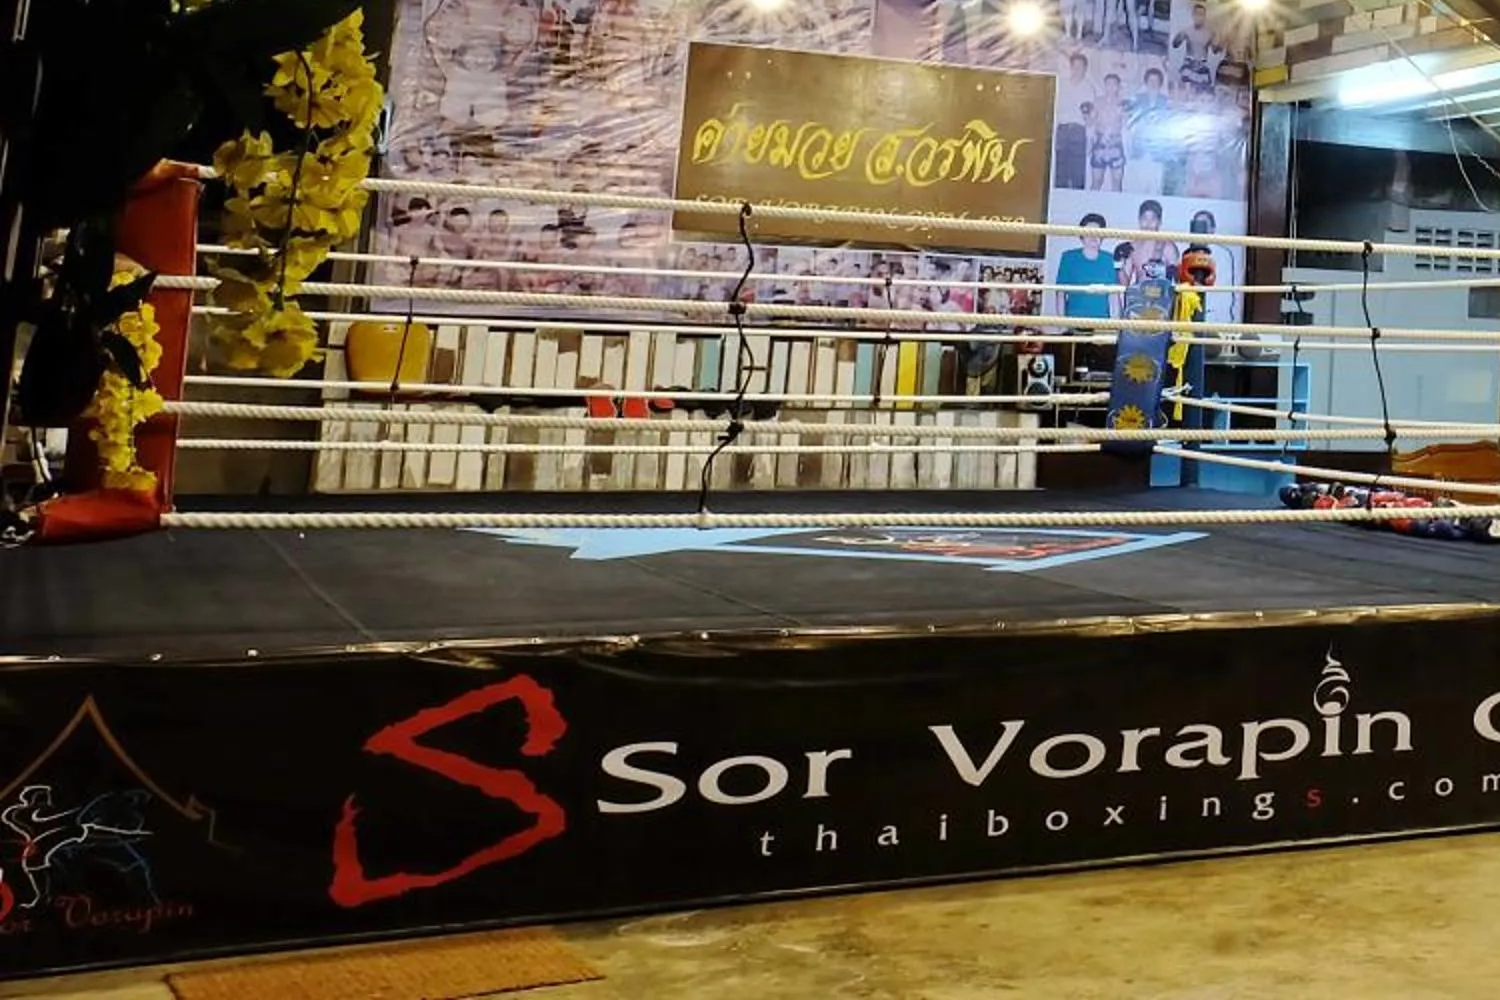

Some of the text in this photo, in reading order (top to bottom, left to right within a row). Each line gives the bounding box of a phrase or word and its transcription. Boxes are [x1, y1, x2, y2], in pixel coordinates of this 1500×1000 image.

[691, 103, 862, 179] ค่ายมวย
[597, 740, 853, 813] Sor
[928, 676, 1413, 787] Vorapin
